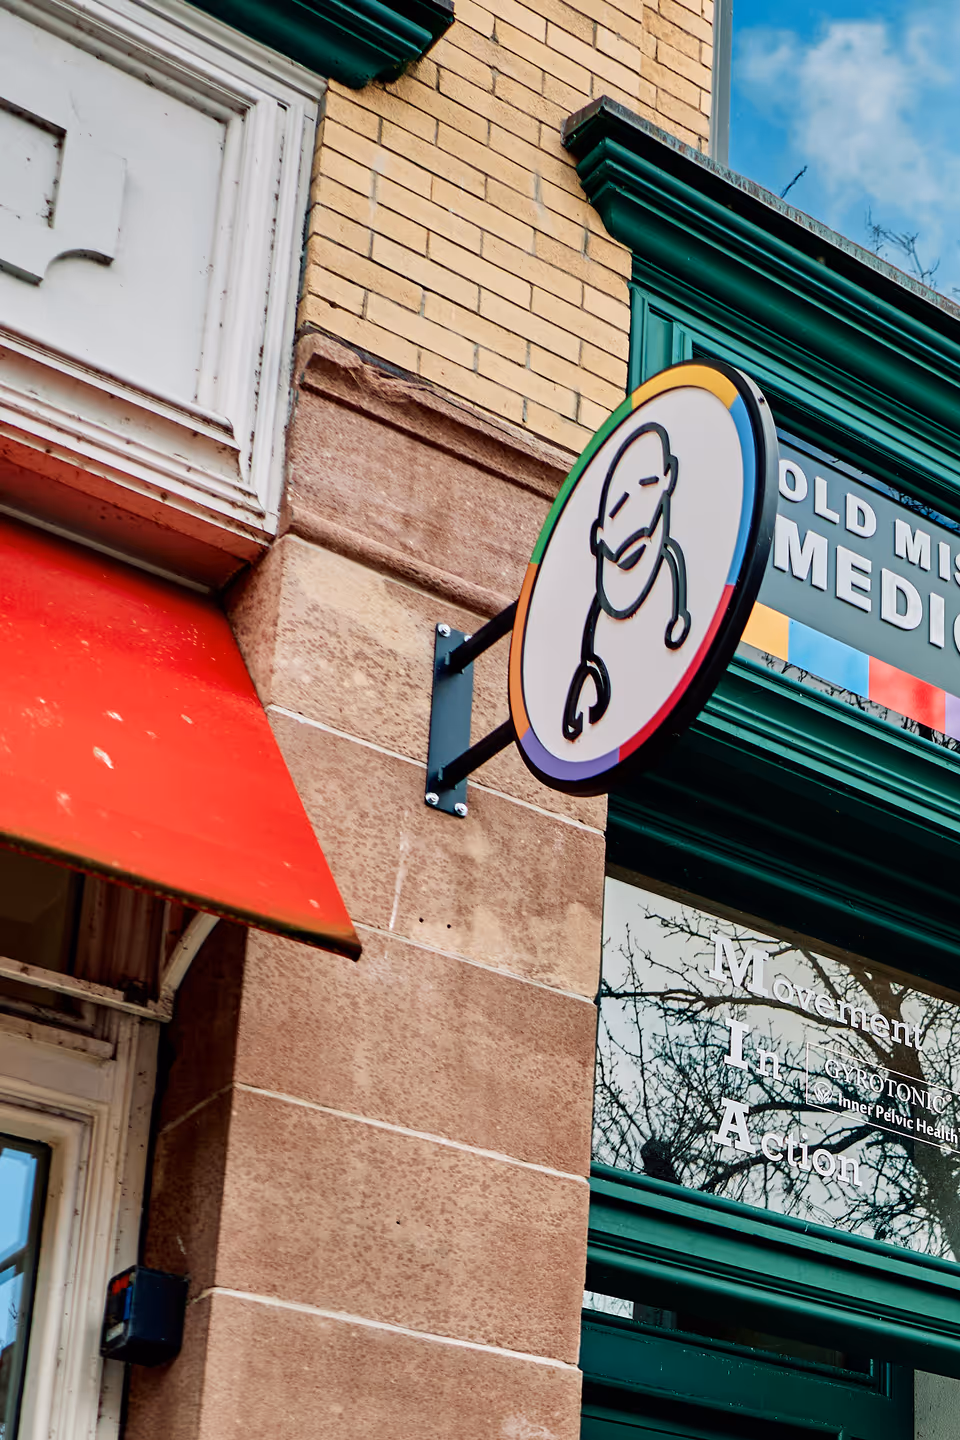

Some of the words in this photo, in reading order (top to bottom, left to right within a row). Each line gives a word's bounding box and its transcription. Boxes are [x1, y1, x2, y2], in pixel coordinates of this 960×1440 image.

[777, 458, 877, 539] OLD
[708, 932, 924, 1050] Movement
[723, 1017, 783, 1082] In
[712, 1097, 863, 1188] Action
[838, 1092, 873, 1116] Inner
[876, 1104, 914, 1129] Pelvic
